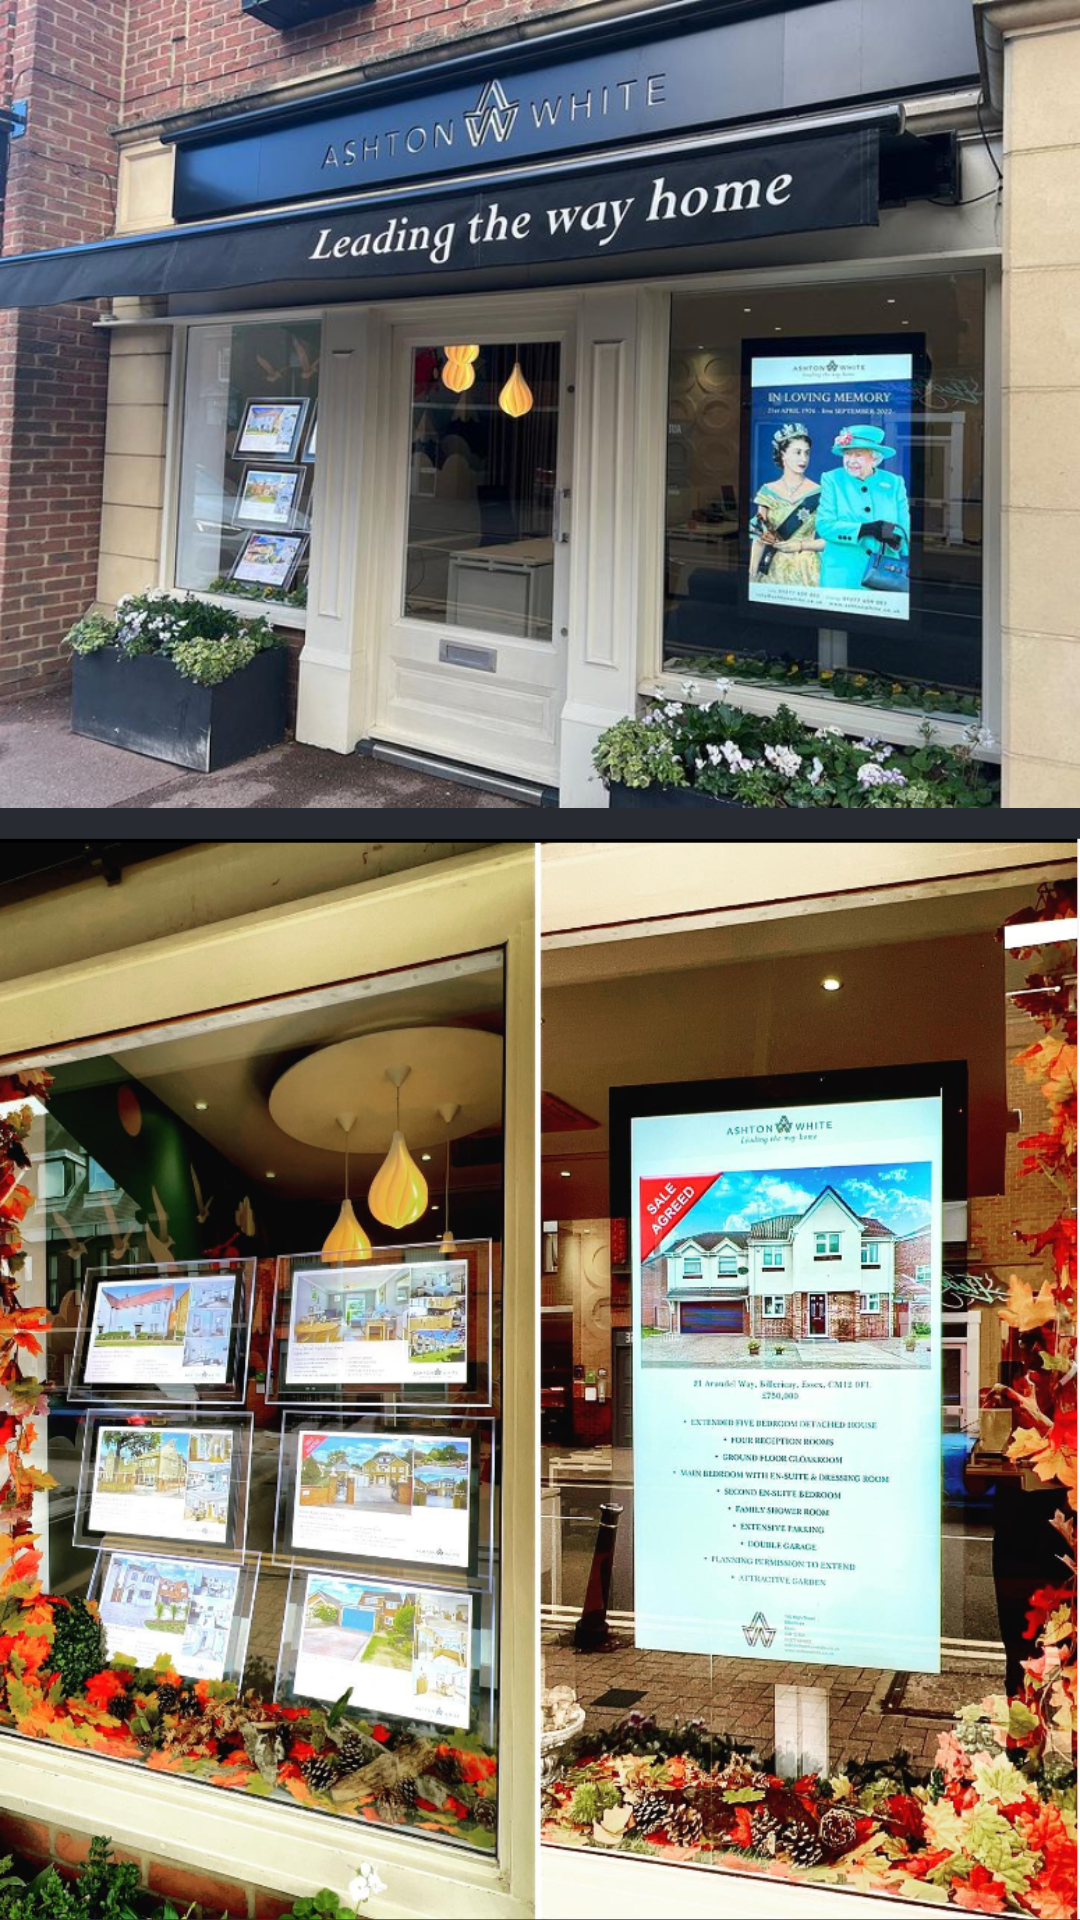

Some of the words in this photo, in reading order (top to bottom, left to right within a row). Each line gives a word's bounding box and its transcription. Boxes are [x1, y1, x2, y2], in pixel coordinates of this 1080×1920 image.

[321, 119, 455, 170] ASHTON
[530, 72, 667, 129] WHITE
[309, 218, 456, 264] Leading
[467, 203, 531, 245] the
[546, 197, 634, 246] way
[645, 172, 793, 222] home
[768, 392, 781, 403] IN
[784, 392, 831, 403] LOVING
[833, 392, 891, 403] MEMORY
[726, 1125, 773, 1136] ASHTON
[795, 1121, 833, 1131] WHITE
[647, 1182, 677, 1215] SALE
[652, 1186, 695, 1235] AGREED
[690, 1419, 734, 1427] EXTENDED
[735, 1419, 755, 1427] FIVE
[756, 1419, 798, 1428] BEDROOM
[800, 1420, 845, 1429] DETACHED
[847, 1420, 877, 1430] HOUSE
[731, 1436, 754, 1445] FOUR
[755, 1437, 802, 1446] RECEPTION
[803, 1437, 834, 1446] ROOMS
[722, 1453, 758, 1462] GROUND
[760, 1454, 787, 1463] FLOOR
[681, 1469, 702, 1477] MAIN
[703, 1469, 744, 1479] BEDROOM
[745, 1471, 769, 1479] WITH
[819, 1473, 861, 1483] DRESSING
[862, 1474, 890, 1483] ROOM
[724, 1487, 757, 1497] SECOND
[799, 1489, 841, 1500] BEDROOM
[735, 1505, 766, 1514] FAMILY
[766, 1506, 802, 1515] SHOWER
[803, 1507, 830, 1517] ROOM
[740, 1523, 787, 1532] EXTENSIVE
[787, 1524, 825, 1534] PARKING
[748, 1540, 782, 1550] DOUBLE
[782, 1541, 817, 1551] GARAGE
[711, 1555, 754, 1565] PLANNING
[754, 1557, 805, 1568] PERMISSION
[806, 1560, 819, 1569] TO
[820, 1561, 856, 1571] EXTEND
[738, 1574, 791, 1585] ATTRACTIVE
[792, 1577, 826, 1586] GARDEN
